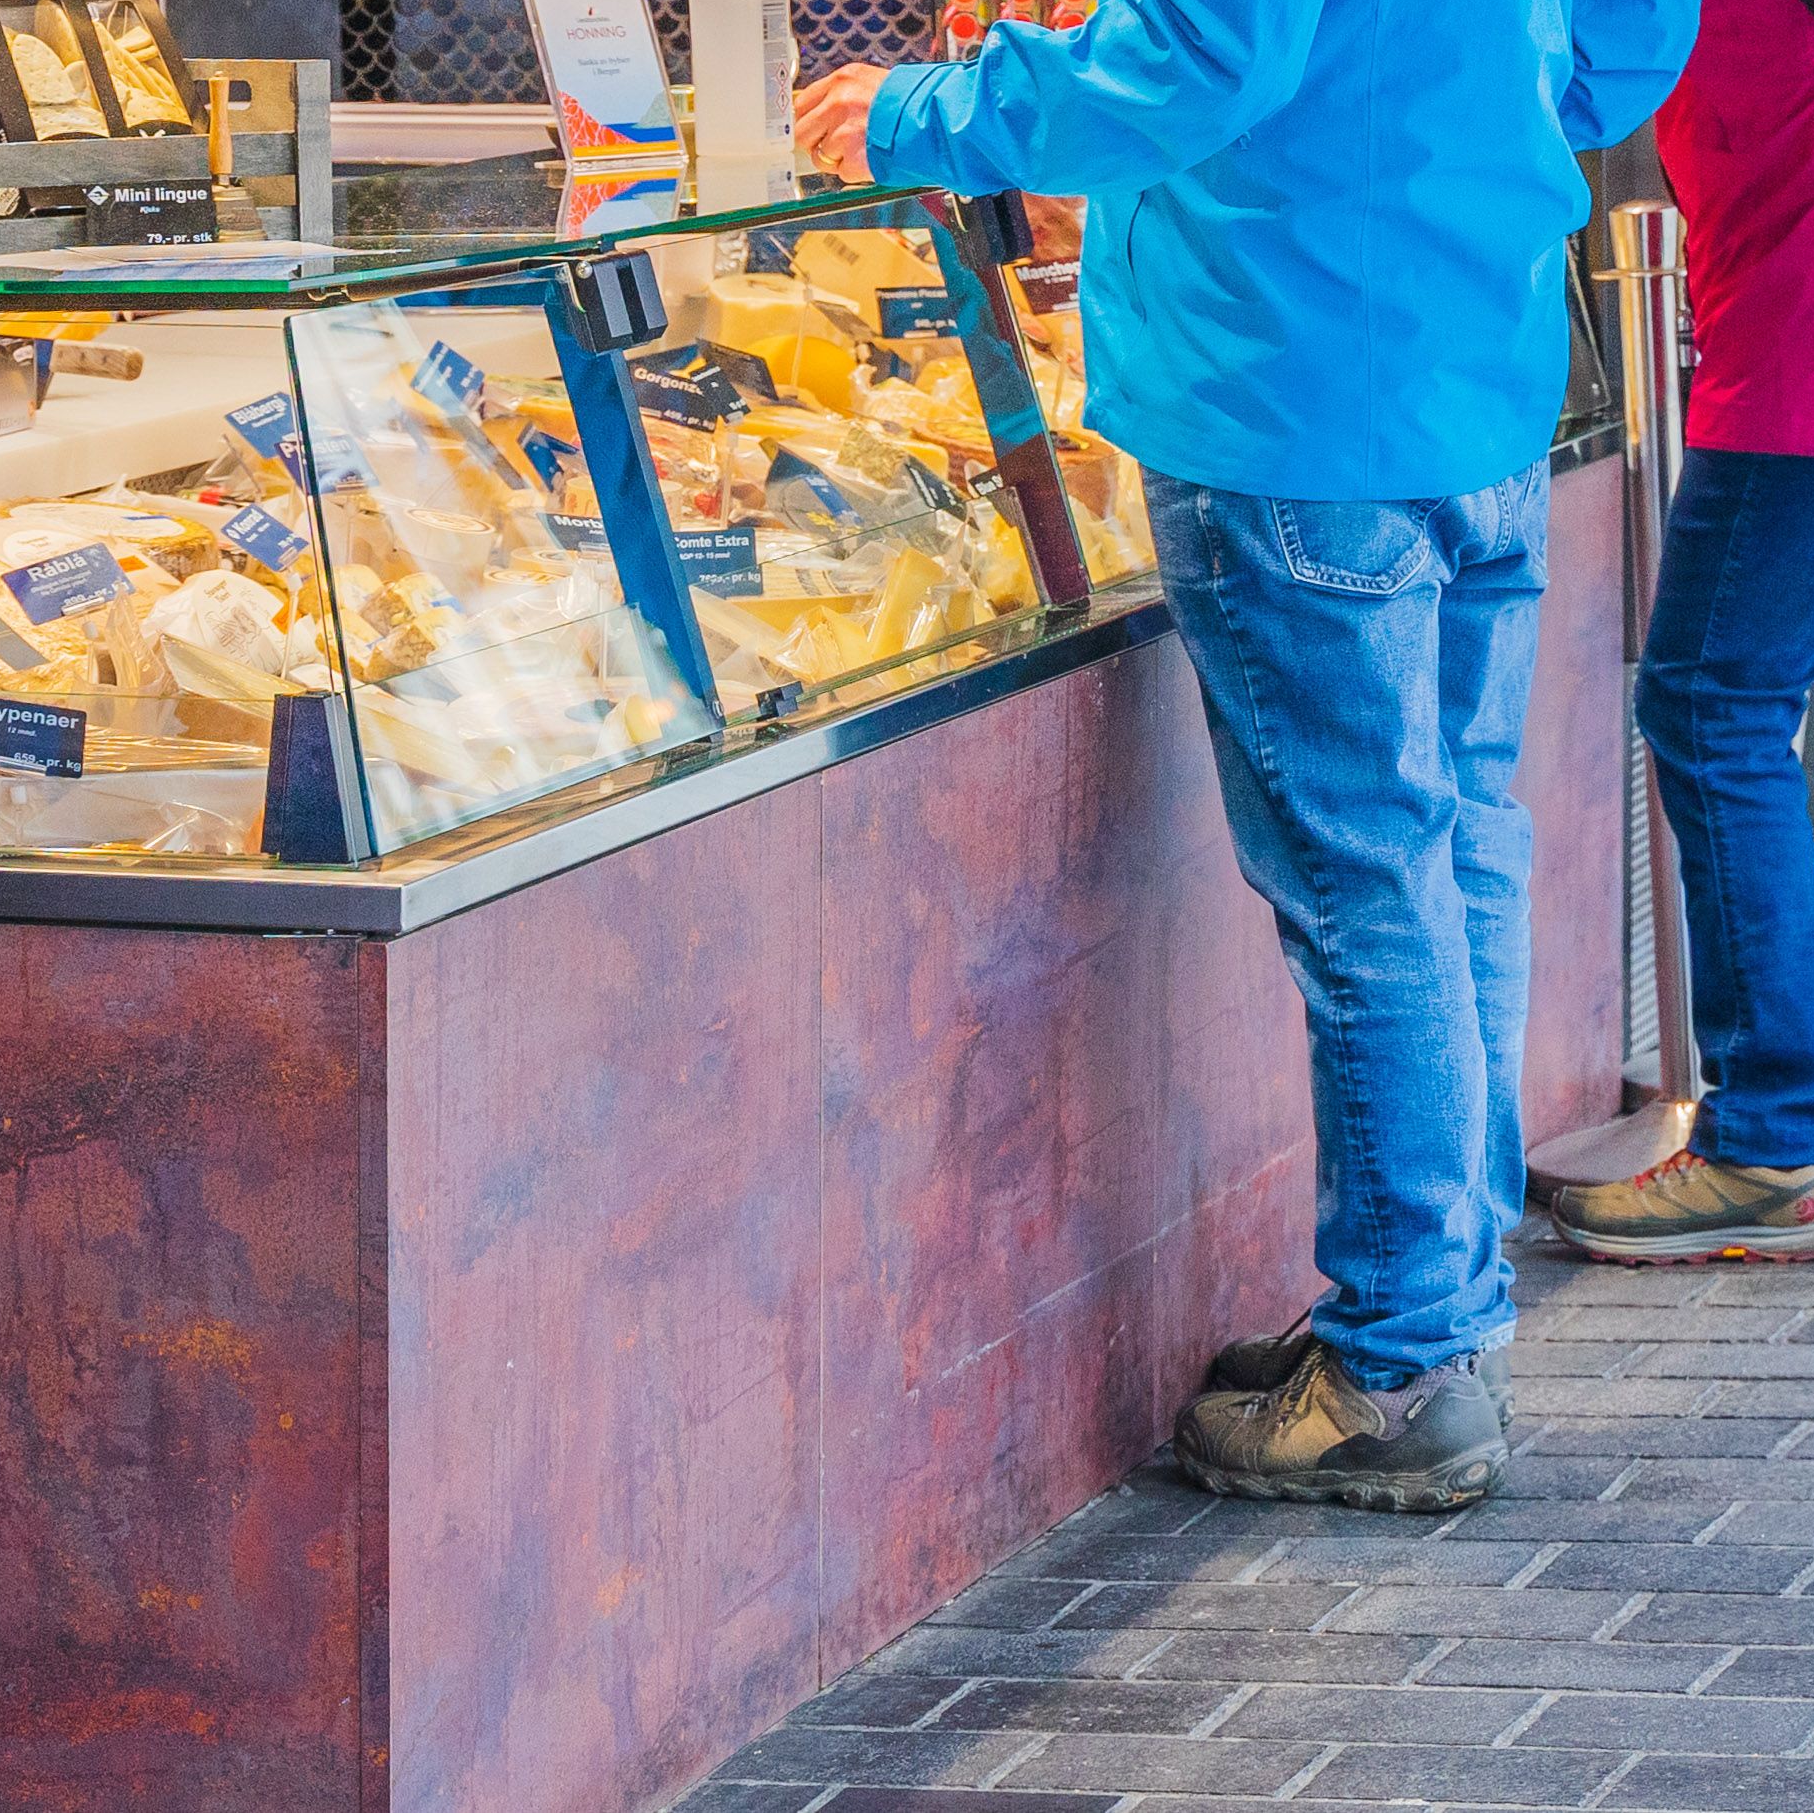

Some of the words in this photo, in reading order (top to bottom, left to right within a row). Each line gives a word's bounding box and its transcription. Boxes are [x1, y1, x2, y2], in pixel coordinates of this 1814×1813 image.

[566, 25, 627, 41] HONNING
[114, 187, 150, 202] Mini
[155, 187, 208, 204] lingue
[146, 233, 171, 244] 79,-
[173, 234, 191, 244] pr.
[193, 232, 213, 243] stk
[715, 535, 749, 548] Extra
[27, 552, 88, 582] Råblå
[732, 573, 746, 583] pr.
[747, 572, 761, 582] kg
[47, 758, 63, 769] pr.
[66, 759, 82, 773] kg
